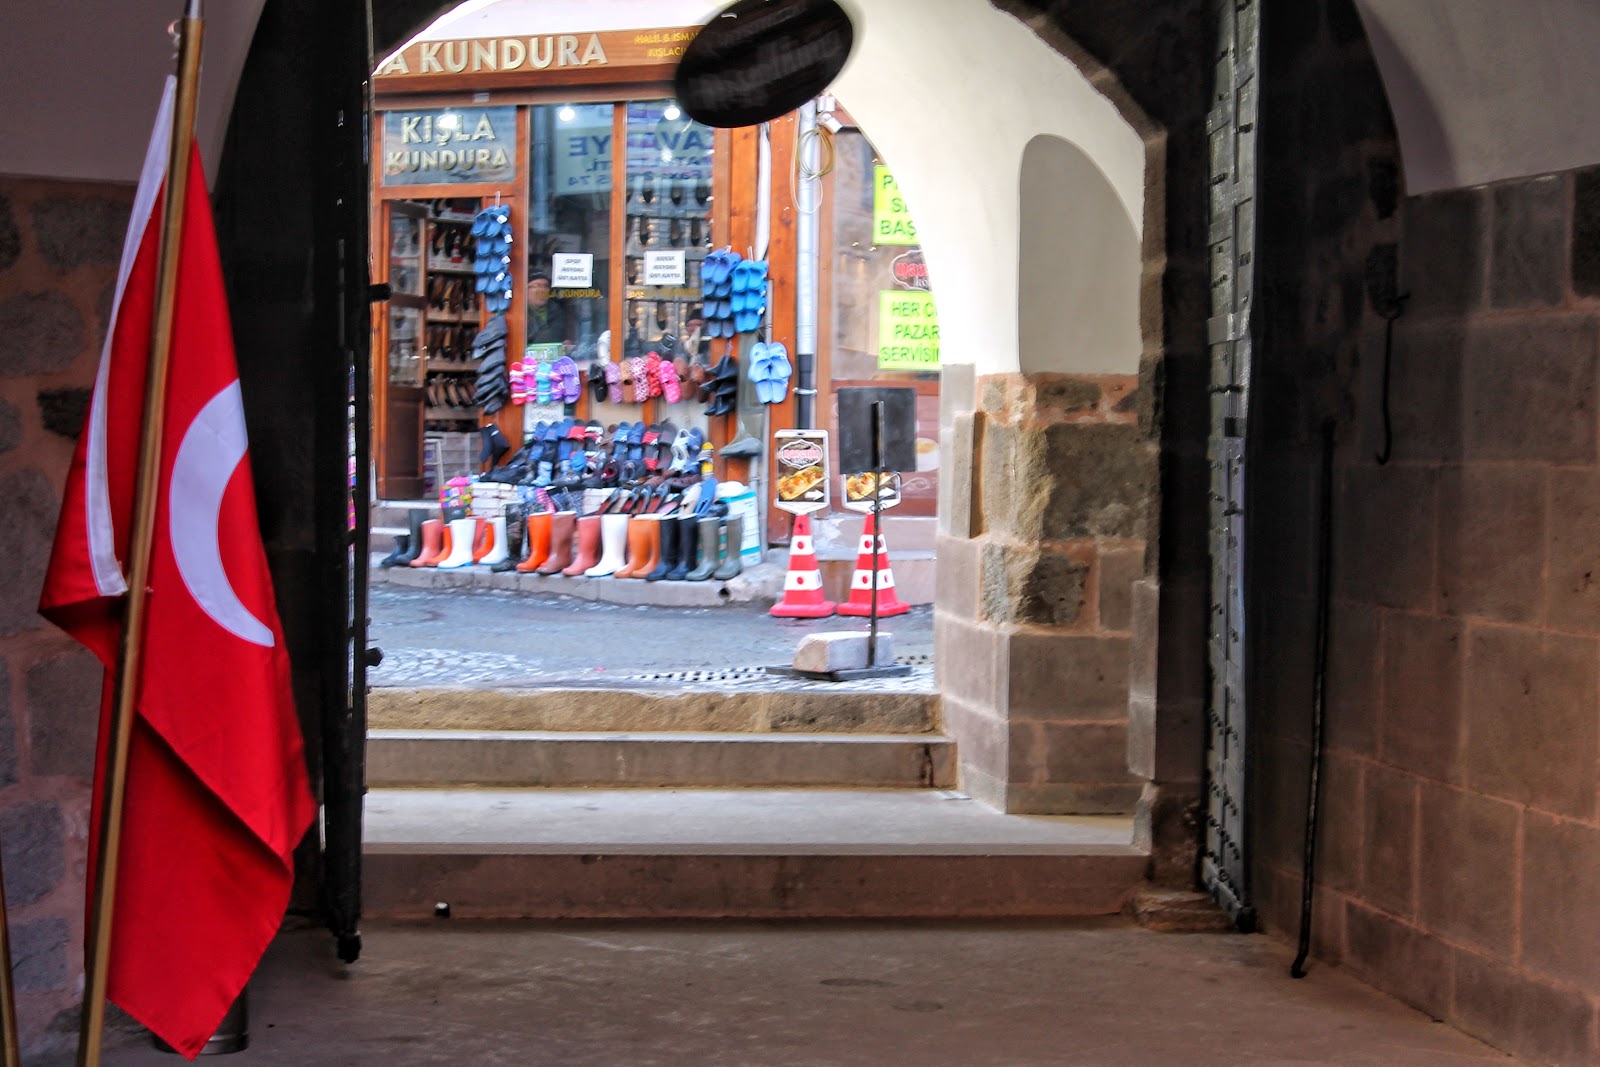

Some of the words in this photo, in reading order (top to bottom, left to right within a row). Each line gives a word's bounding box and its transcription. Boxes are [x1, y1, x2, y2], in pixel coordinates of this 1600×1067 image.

[419, 33, 608, 73] KUNDURA
[400, 112, 496, 147] KIŞLA
[385, 147, 511, 173] KUNDURA
[892, 302, 920, 317] HER
[894, 324, 941, 340] PAZAR
